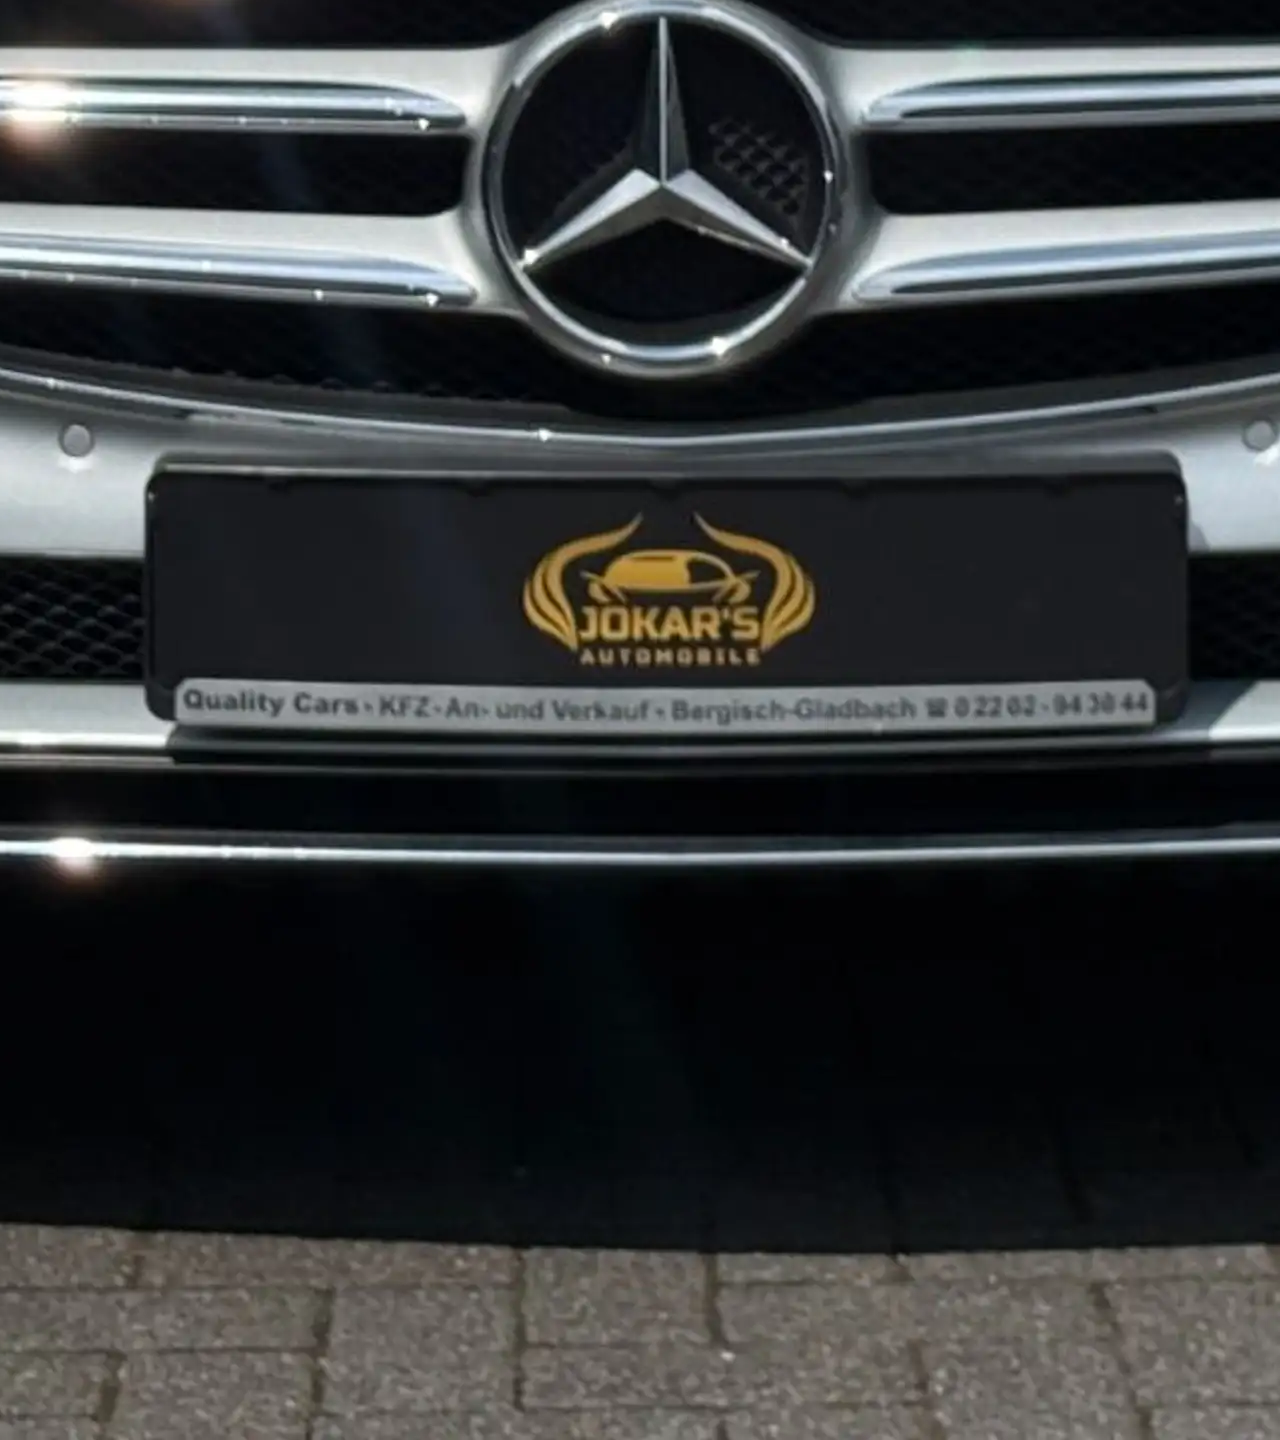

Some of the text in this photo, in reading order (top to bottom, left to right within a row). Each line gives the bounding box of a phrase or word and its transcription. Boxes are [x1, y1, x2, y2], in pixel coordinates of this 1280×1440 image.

[579, 606, 761, 640] JOKAR'S
[580, 647, 761, 666] AUTOMOBILE
[182, 688, 285, 718] Quality
[293, 691, 359, 715] Cars
[495, 698, 544, 721] und
[551, 699, 649, 722] Verkauf
[672, 696, 917, 726] Bergisch-Gladbach
